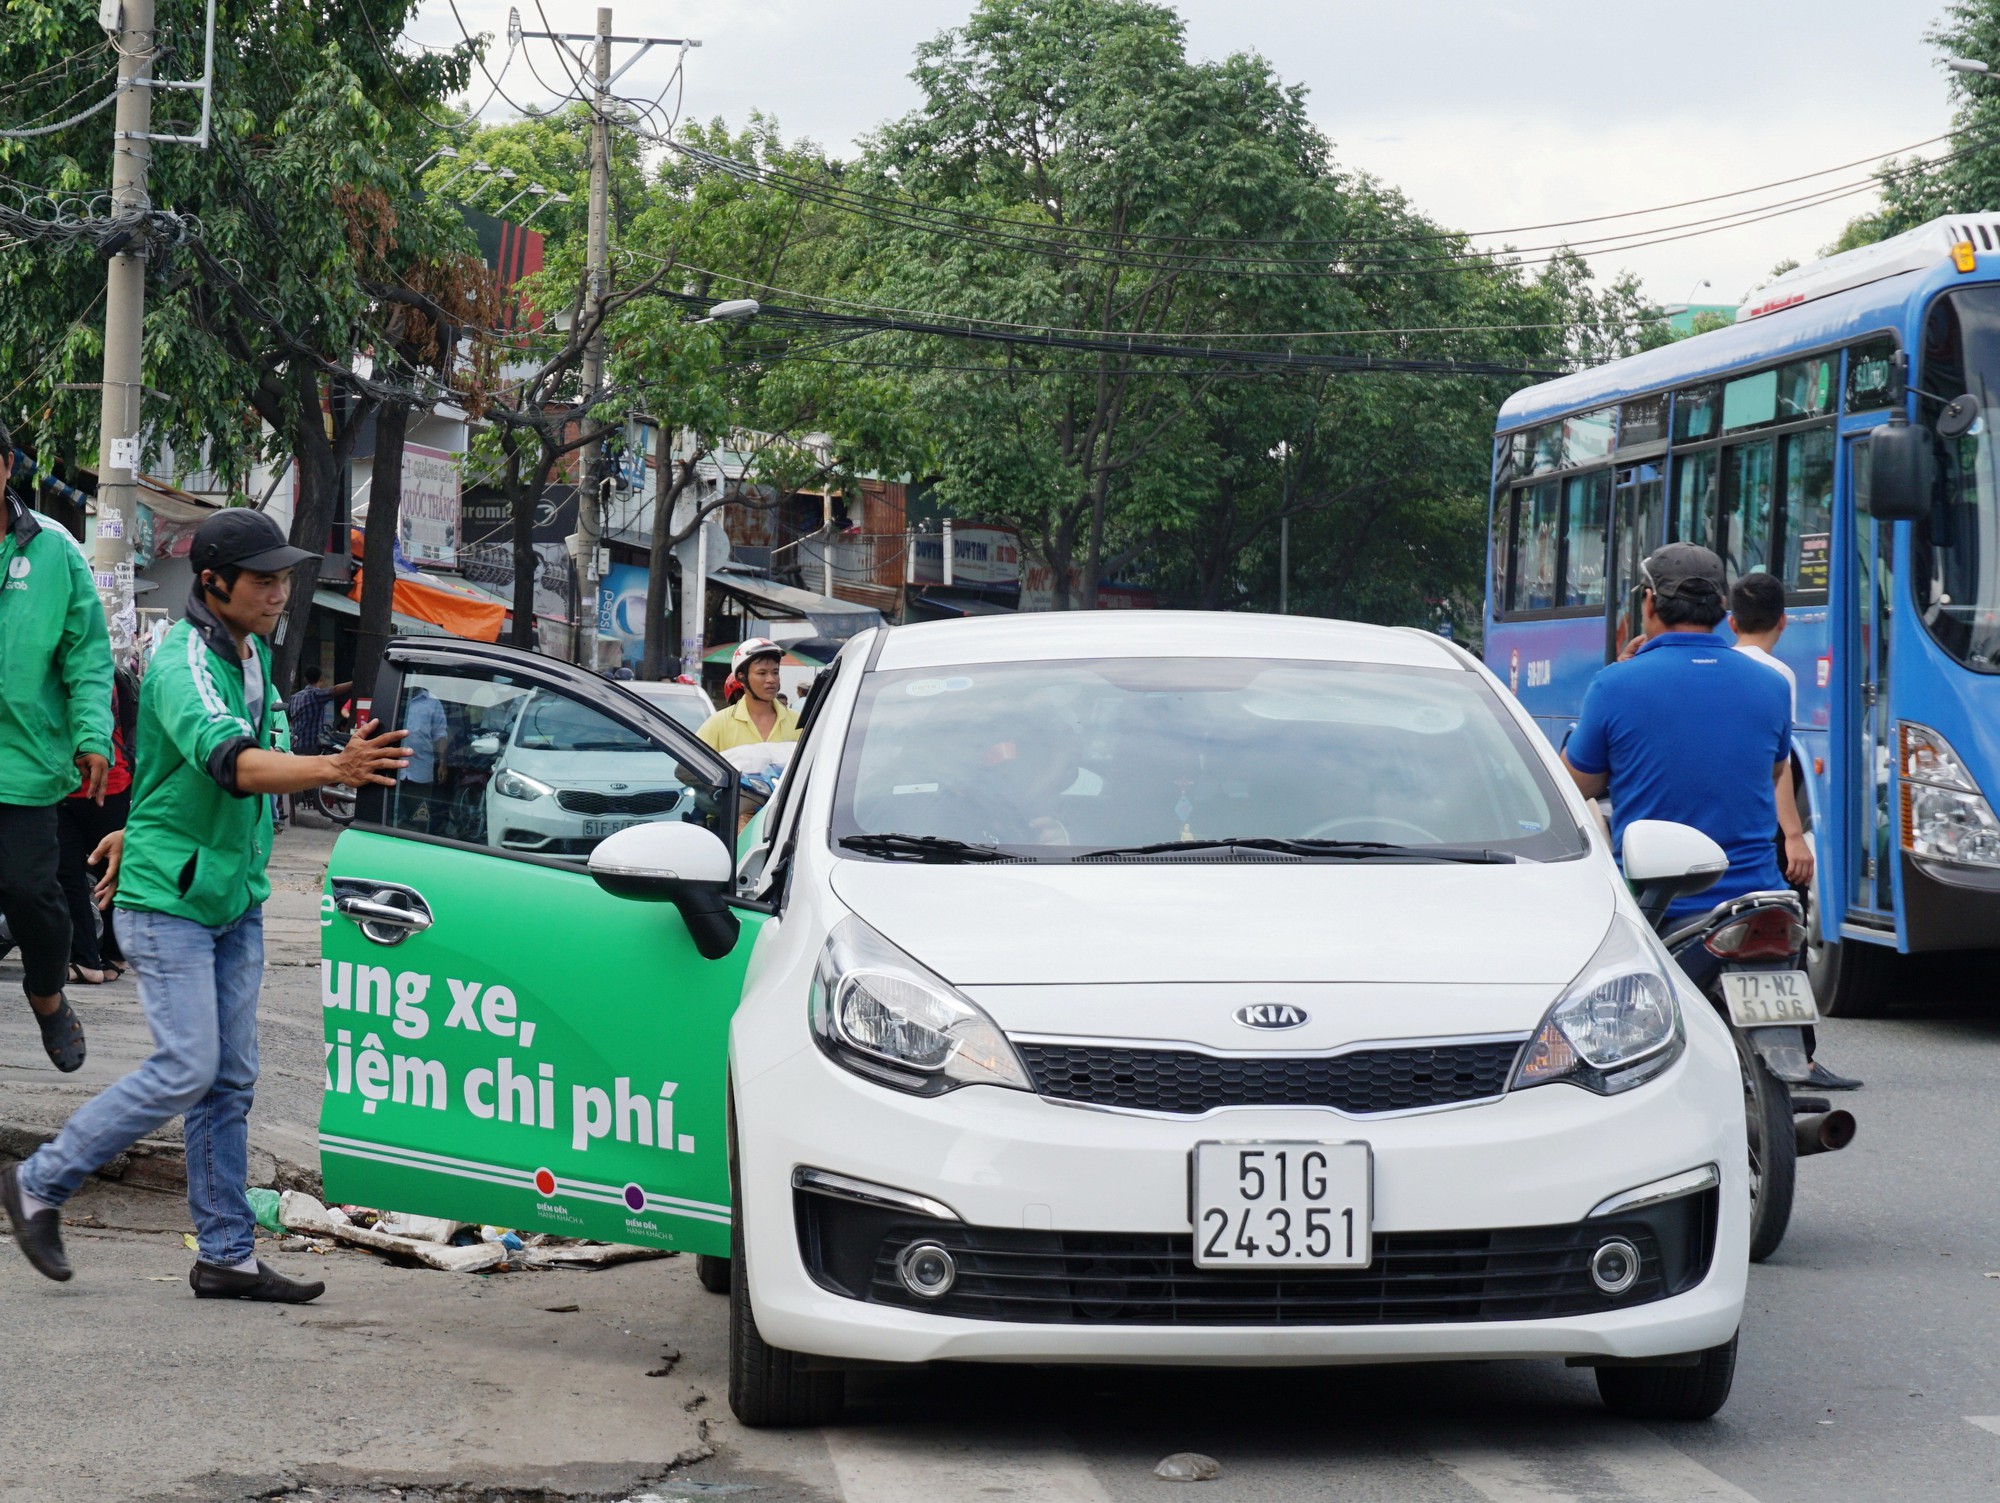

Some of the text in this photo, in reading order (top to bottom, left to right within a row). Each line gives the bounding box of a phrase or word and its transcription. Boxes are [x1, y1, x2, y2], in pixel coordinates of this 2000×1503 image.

[600, 589, 615, 631] pepsi
[444, 978, 536, 1048] xe,
[1246, 1006, 1300, 1023] KIA
[463, 1057, 554, 1130] chi
[571, 1077, 695, 1154] phí.
[1239, 1151, 1327, 1201] 51G
[1203, 1207, 1353, 1258] 243.51
